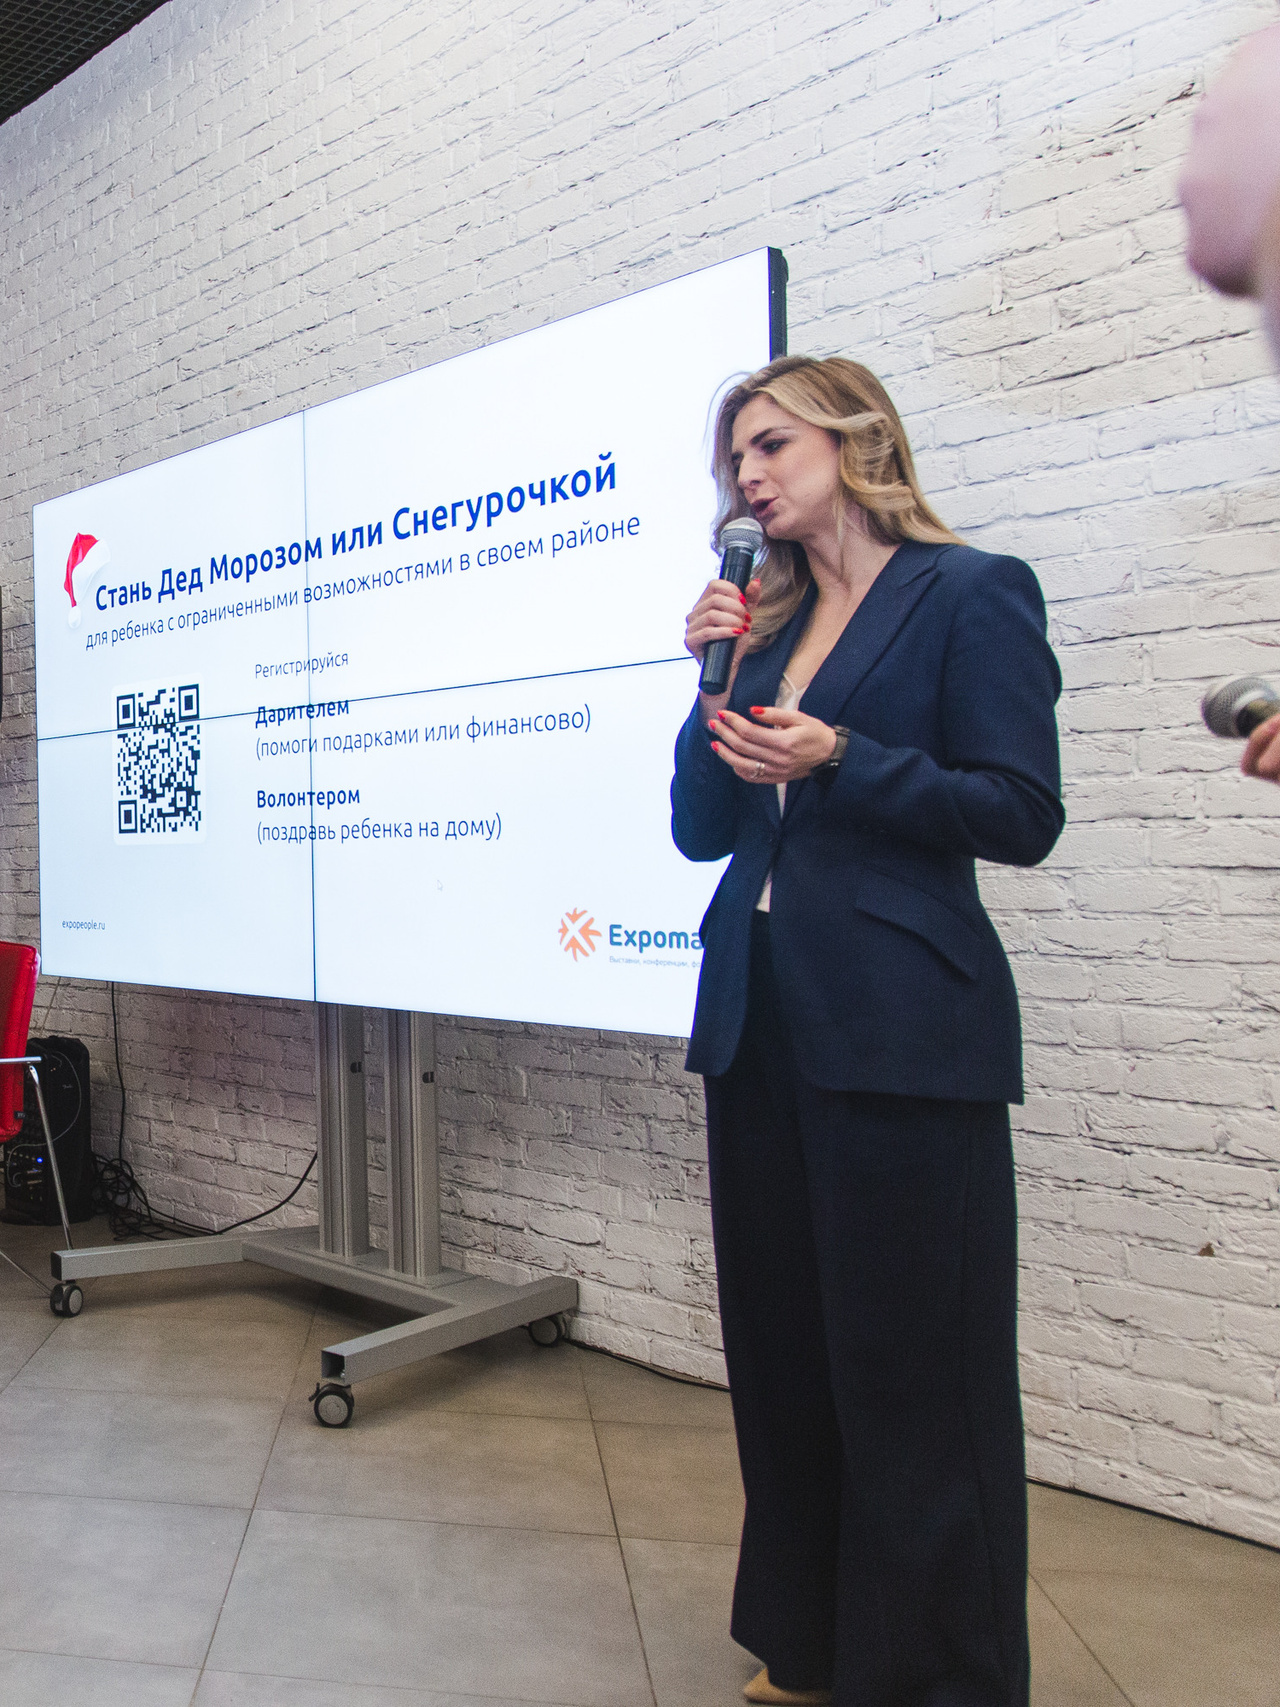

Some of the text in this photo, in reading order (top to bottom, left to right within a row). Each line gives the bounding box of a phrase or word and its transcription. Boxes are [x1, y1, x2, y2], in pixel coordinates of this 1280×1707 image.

[95, 451, 616, 611] Стань Дед Морозом или Снегурочкой
[86, 517, 640, 651] для ребенка с ограниченными возможностями в своем районе
[255, 652, 349, 679] Регистрируйся
[255, 700, 350, 729] Дарителем
[256, 703, 591, 761] (помоги подарками или финансово)
[257, 789, 361, 809] Волонтером
[257, 812, 502, 844] (поздравь ребенка на дому)
[61, 919, 106, 931] expopeople.ru
[609, 924, 704, 953] Expoma
